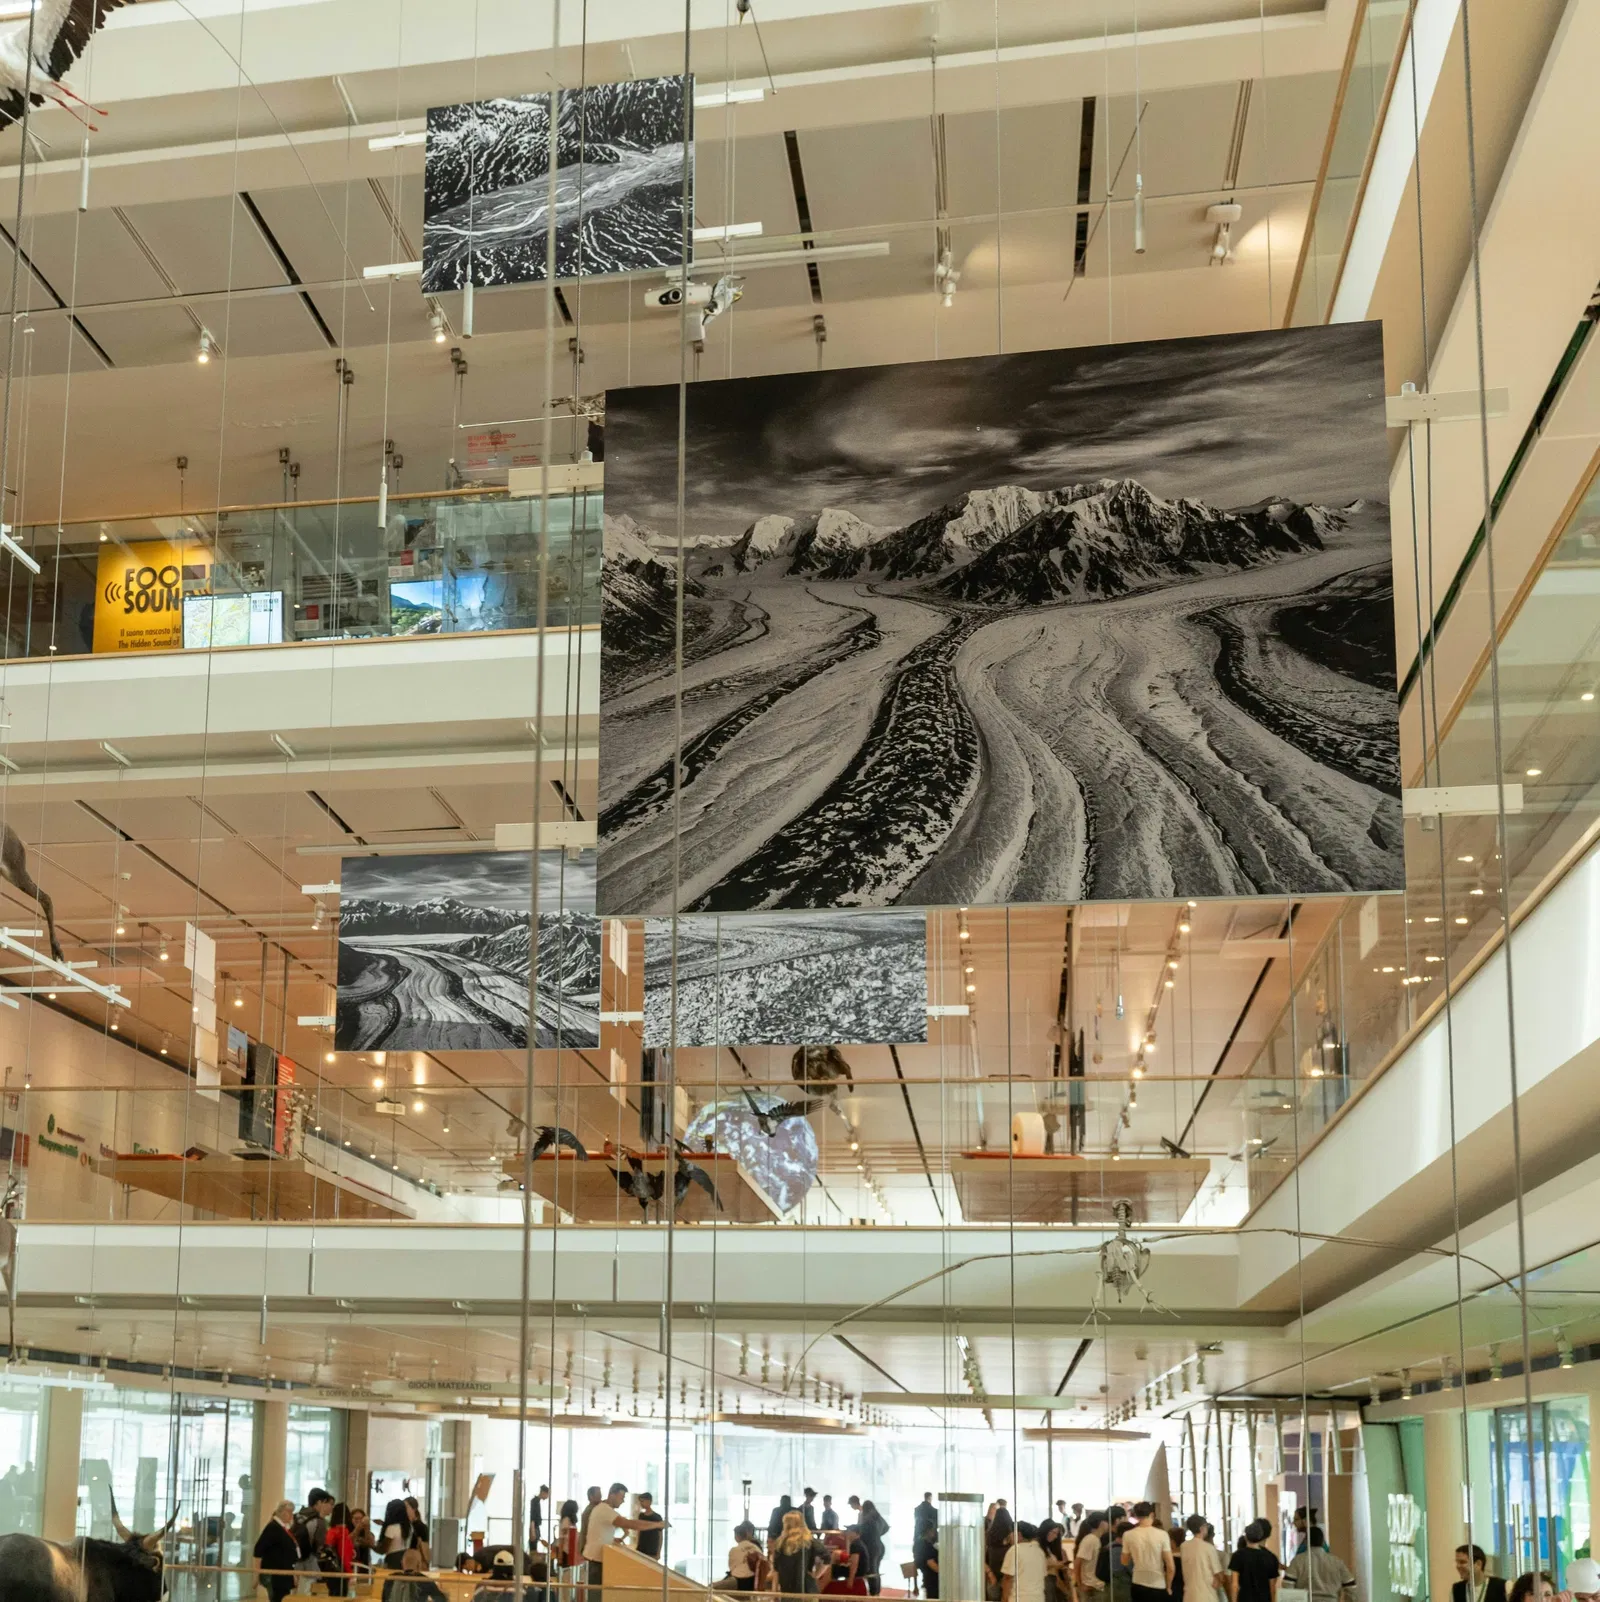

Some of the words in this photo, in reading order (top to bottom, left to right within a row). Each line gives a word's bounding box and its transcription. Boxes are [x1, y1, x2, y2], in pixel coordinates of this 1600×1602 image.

[124, 587, 192, 614] SOUN
[145, 628, 171, 636] nascosto
[118, 640, 129, 649] The
[130, 638, 152, 648] Hidden
[152, 637, 172, 647] Sound
